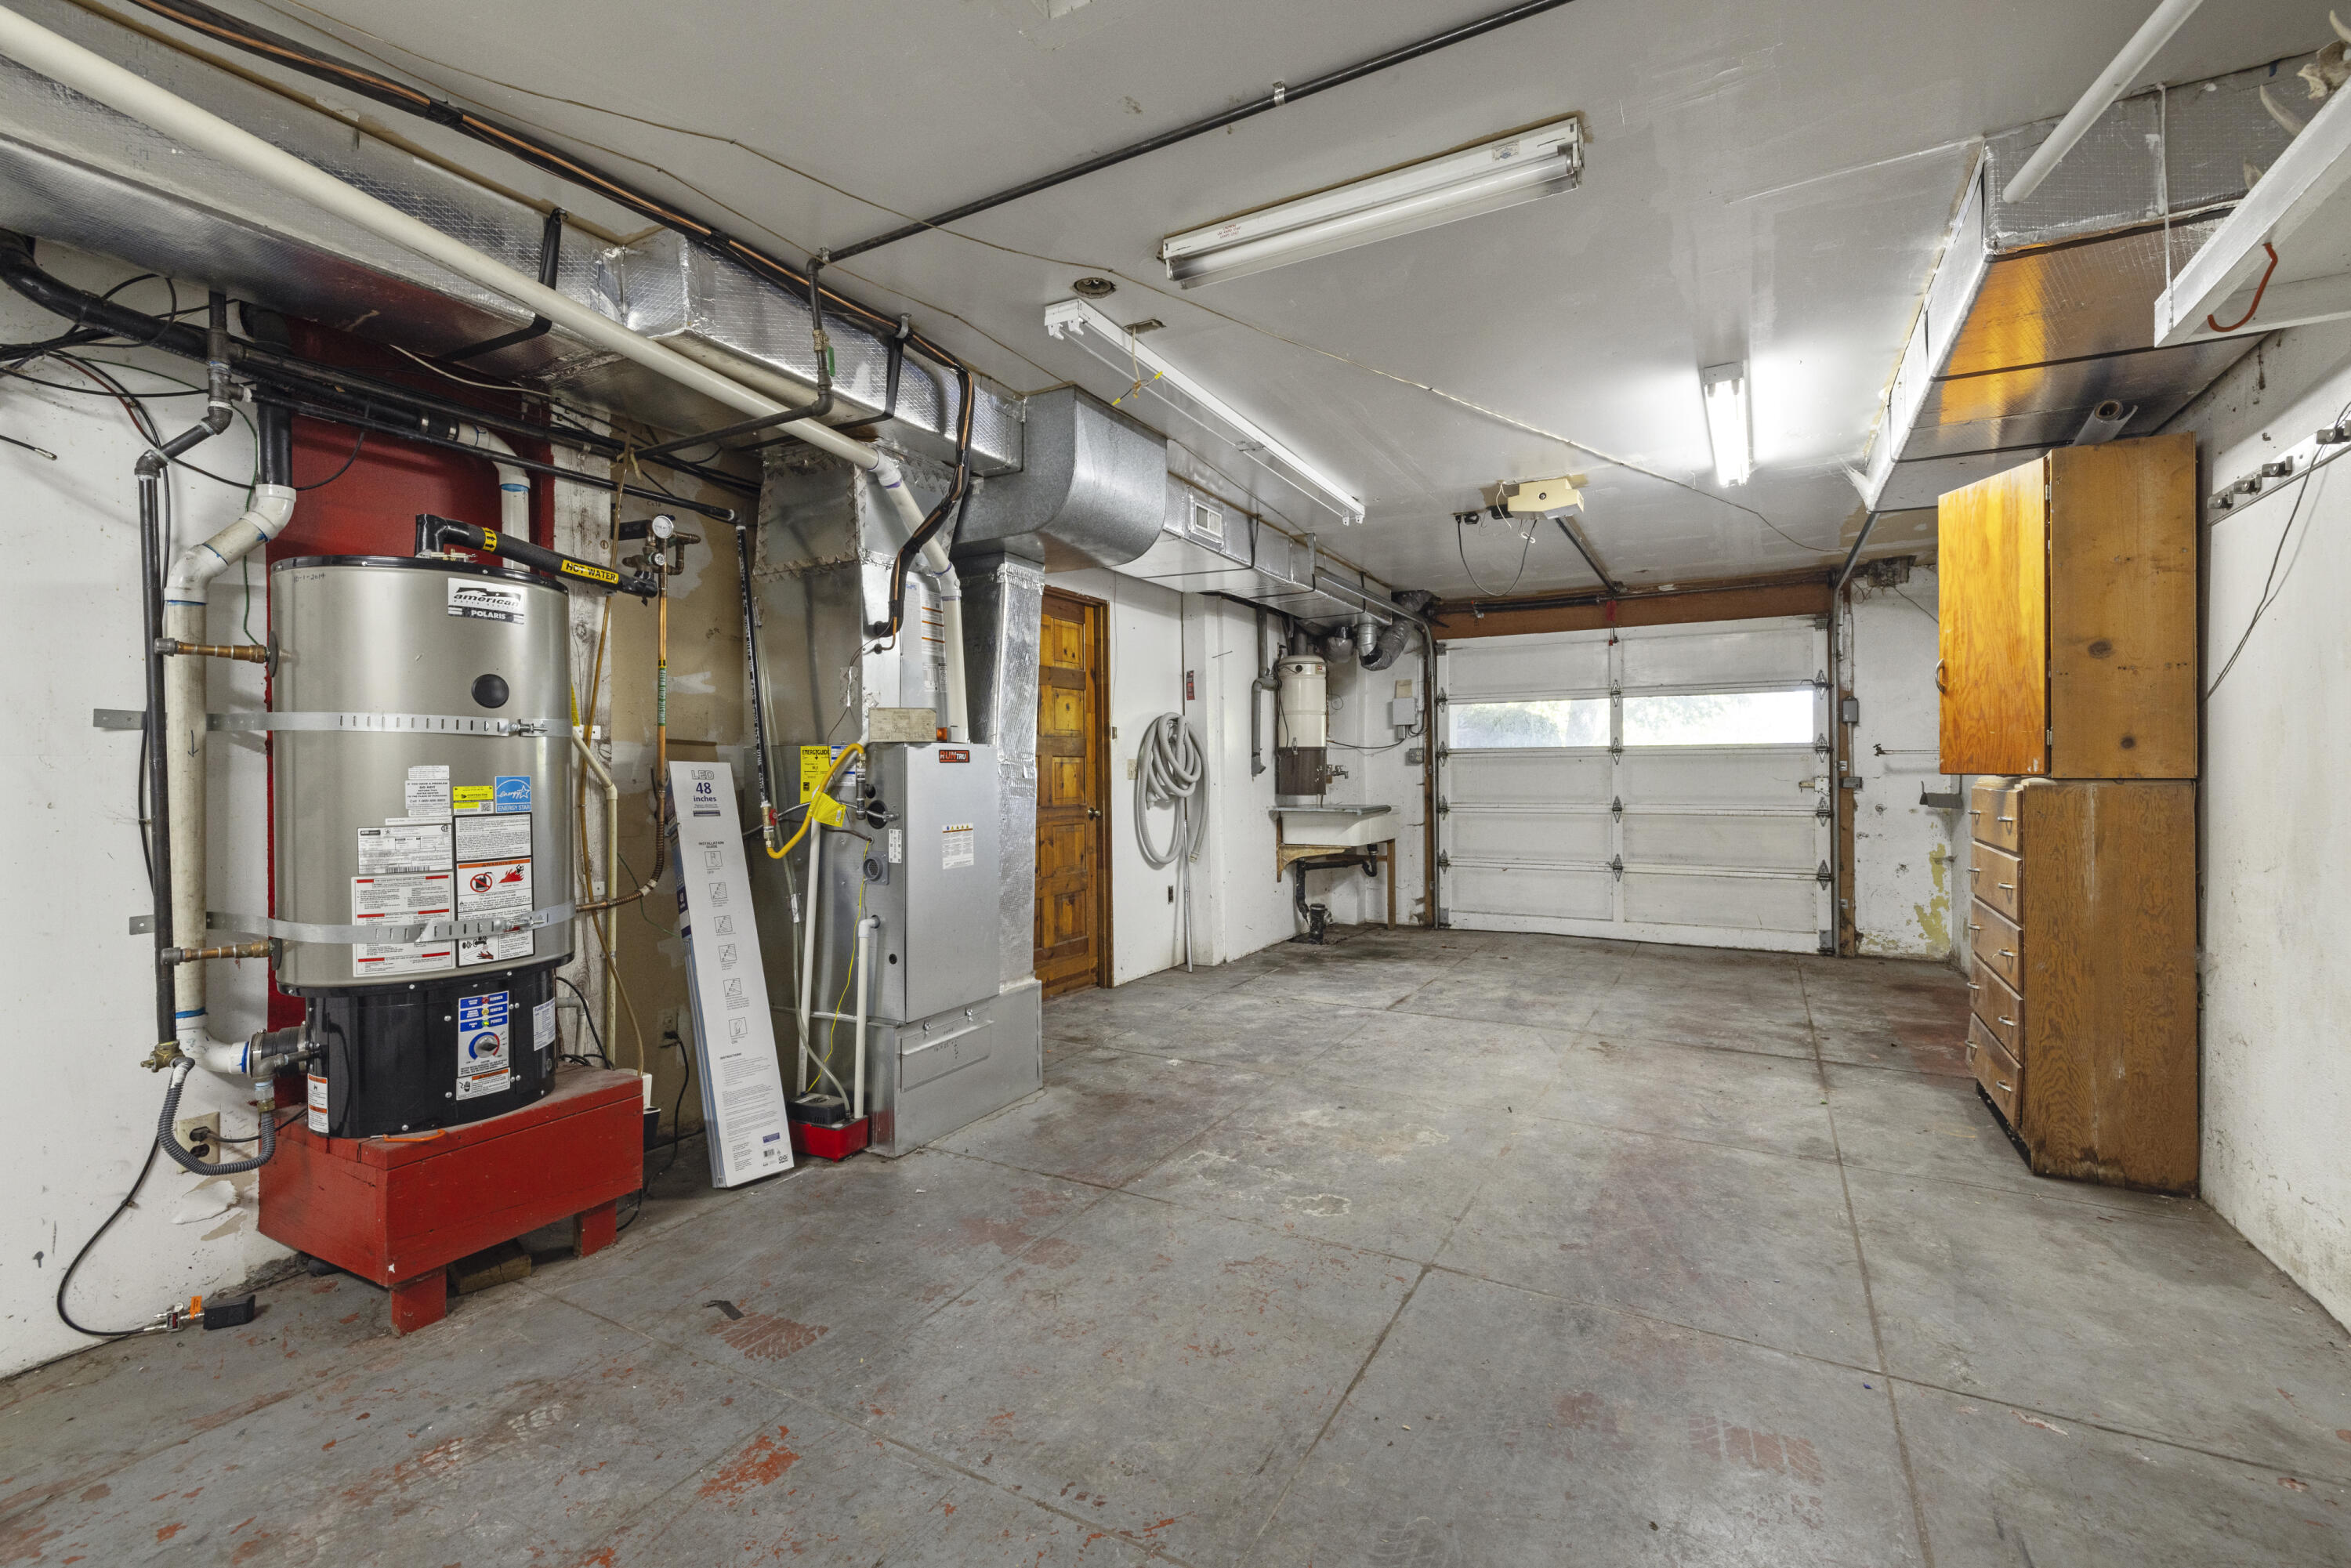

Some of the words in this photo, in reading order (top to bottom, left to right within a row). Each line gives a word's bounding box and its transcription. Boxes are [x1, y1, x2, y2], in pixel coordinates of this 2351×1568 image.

[566, 563, 585, 574] HOT
[587, 567, 616, 581] WATER
[453, 594, 520, 607] american
[470, 609, 506, 620] POLARIS
[690, 770, 715, 780] LED
[695, 782, 712, 794] 48
